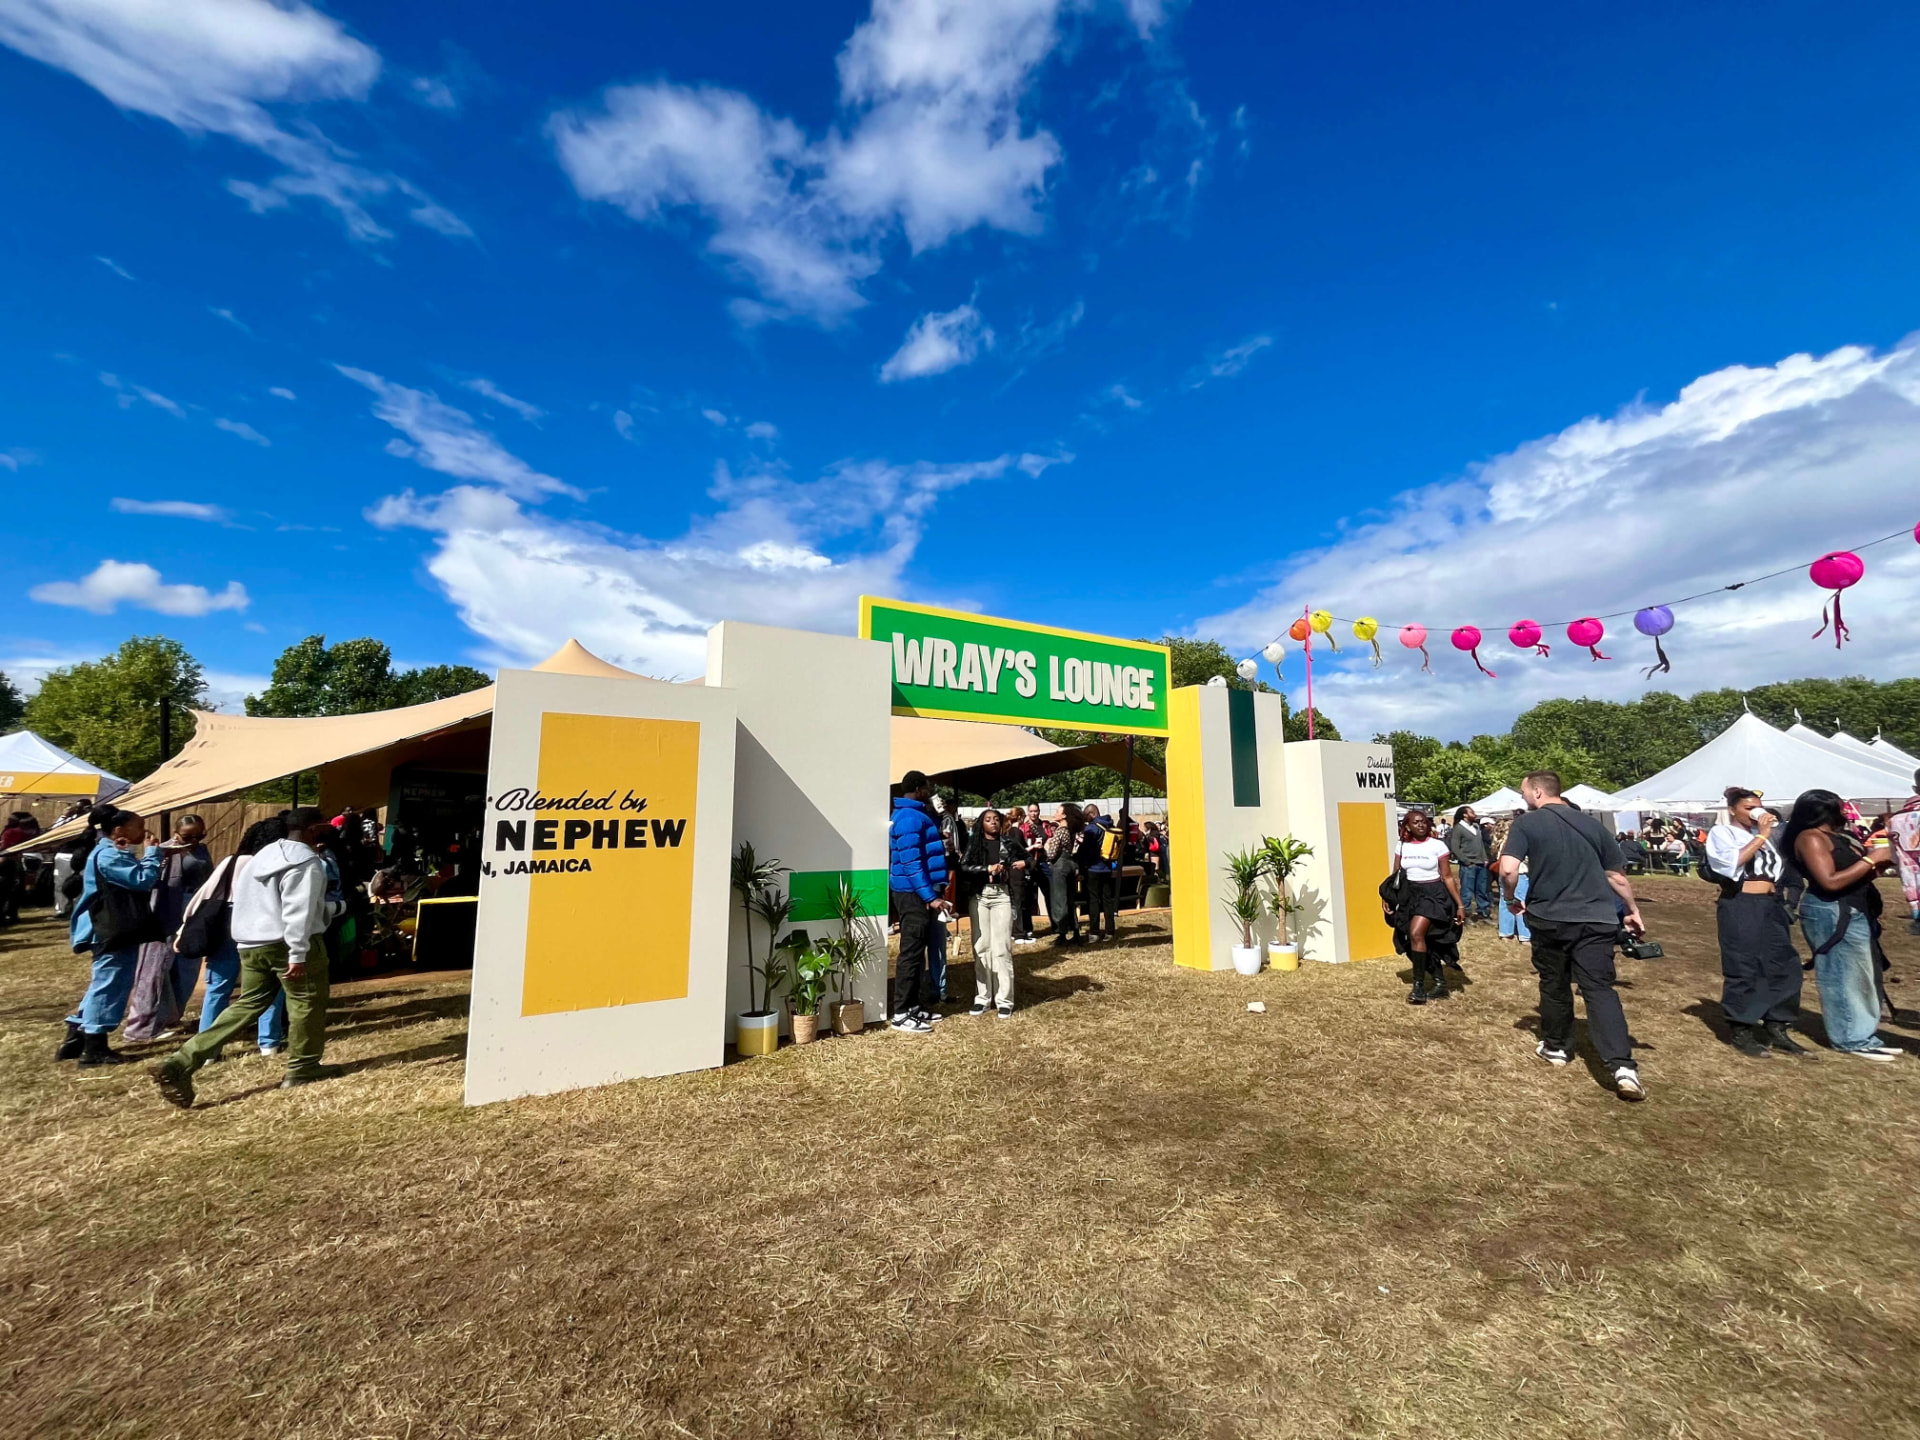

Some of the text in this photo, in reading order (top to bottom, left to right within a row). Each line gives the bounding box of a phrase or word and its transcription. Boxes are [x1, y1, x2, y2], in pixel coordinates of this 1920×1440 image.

[891, 632, 1155, 711] WRAY'S LOUNGE
[1355, 771, 1391, 788] WRAY
[495, 788, 648, 813] Blended by
[495, 818, 687, 851] NEPHEW
[503, 858, 592, 875] JAMAICA
